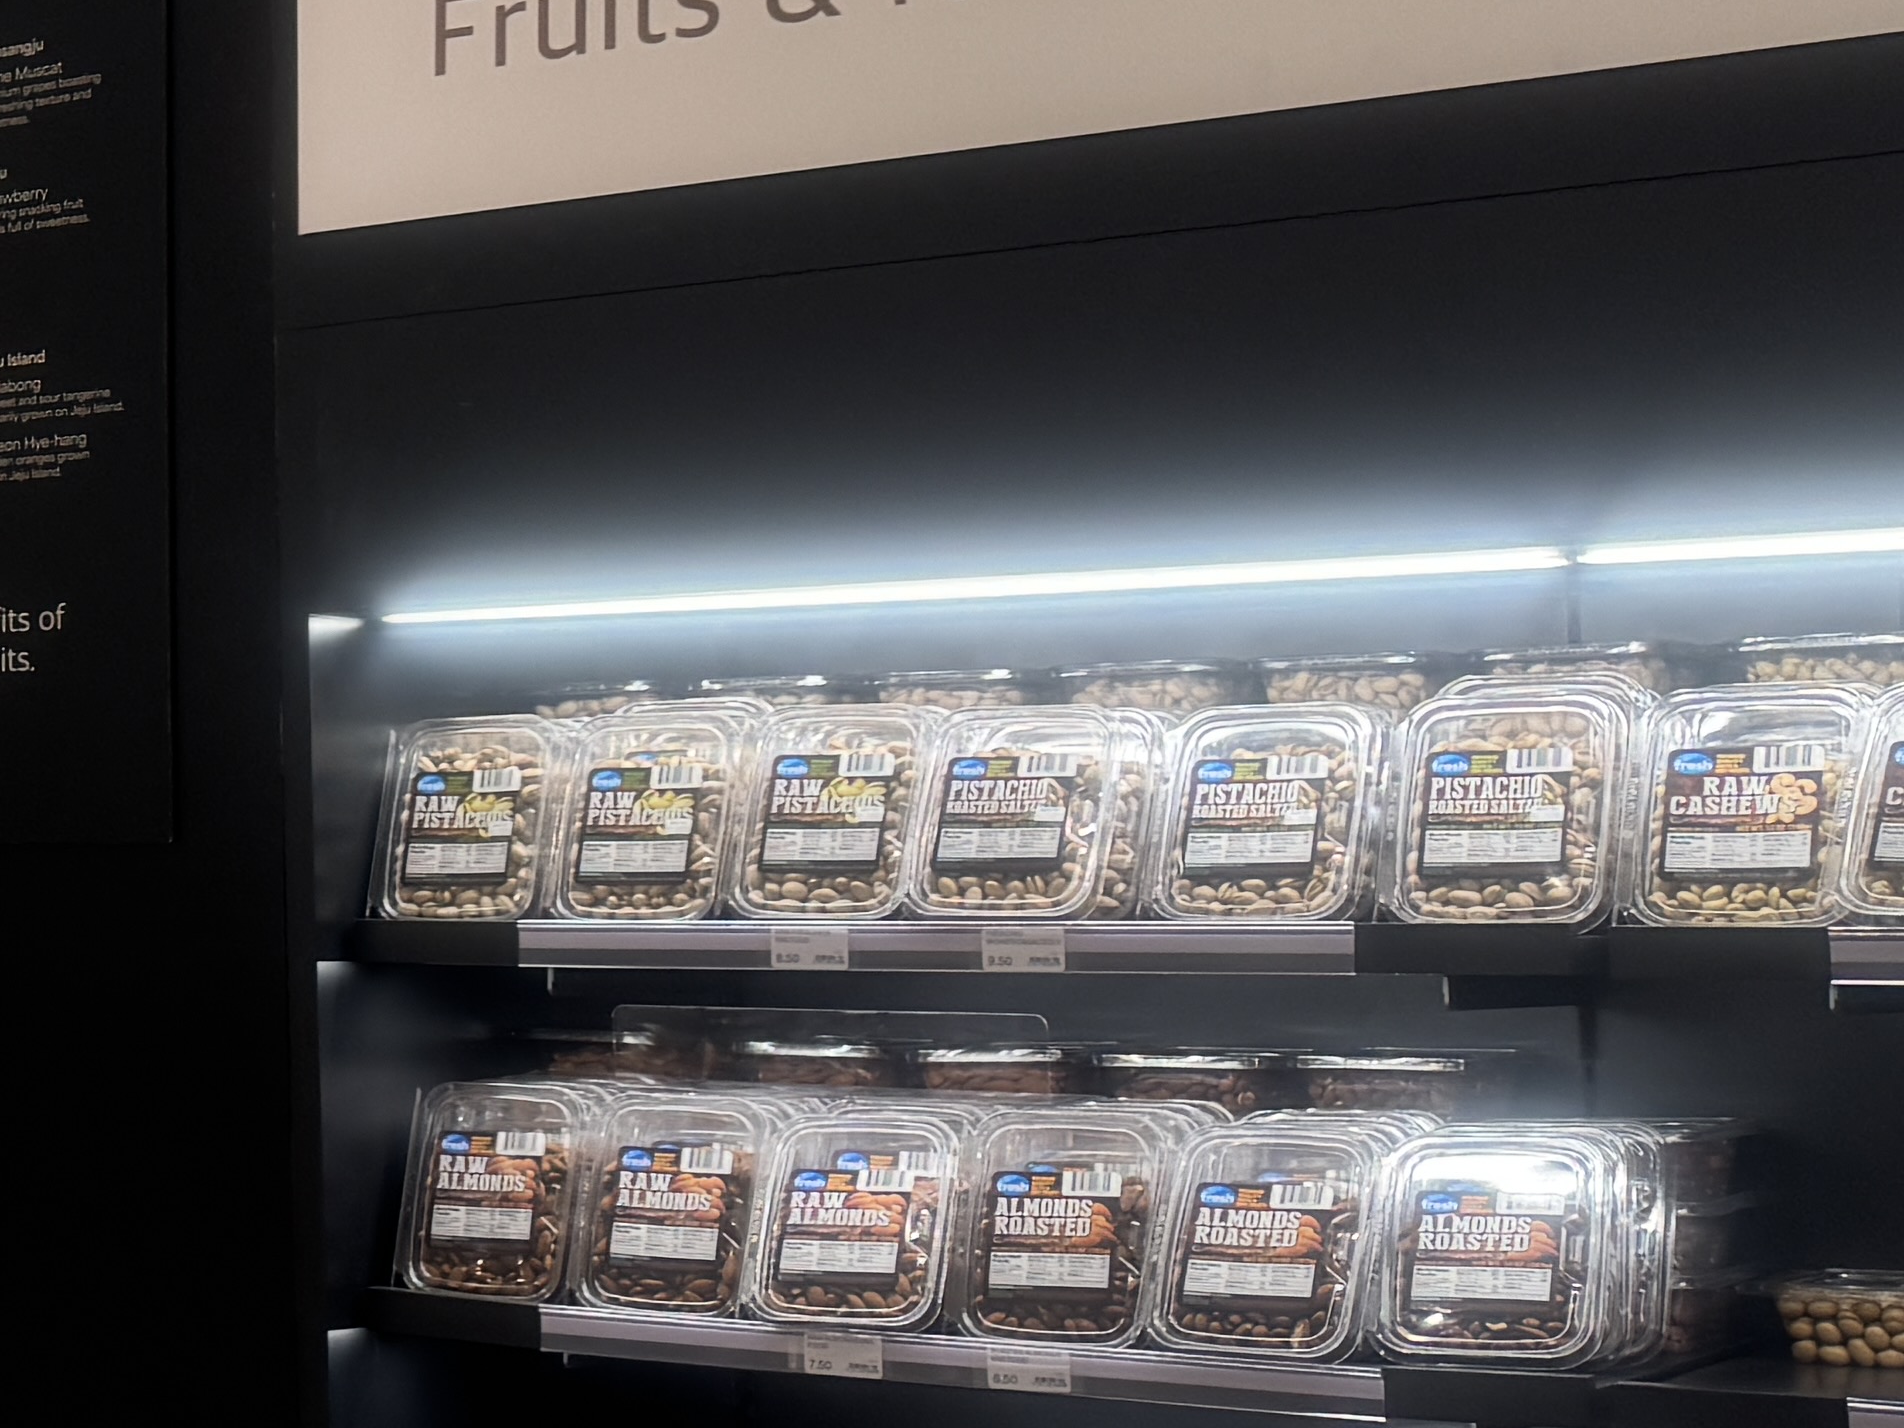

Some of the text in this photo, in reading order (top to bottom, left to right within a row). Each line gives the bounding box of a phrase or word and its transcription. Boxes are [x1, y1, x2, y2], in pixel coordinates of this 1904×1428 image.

[7, 350, 46, 366] Island
[38, 602, 66, 631] of
[774, 778, 824, 797] RAW
[1431, 775, 1543, 800] PISTACHIO
[1703, 775, 1769, 796] RAW
[414, 795, 460, 813] RAW
[1429, 799, 1488, 815] ROASTED
[1669, 794, 1797, 816] CASHEWS
[438, 1155, 489, 1174] RAW
[436, 1172, 527, 1193] ALMONDS
[790, 1191, 846, 1209] RAW
[995, 1197, 1094, 1218] ALMONDS
[1200, 1192, 1236, 1206] fresh
[786, 1208, 893, 1228] ALMONDS
[994, 1215, 1092, 1236] ROASTED
[1194, 1207, 1302, 1230] ALMONDS
[1193, 1226, 1298, 1248] ROASTED
